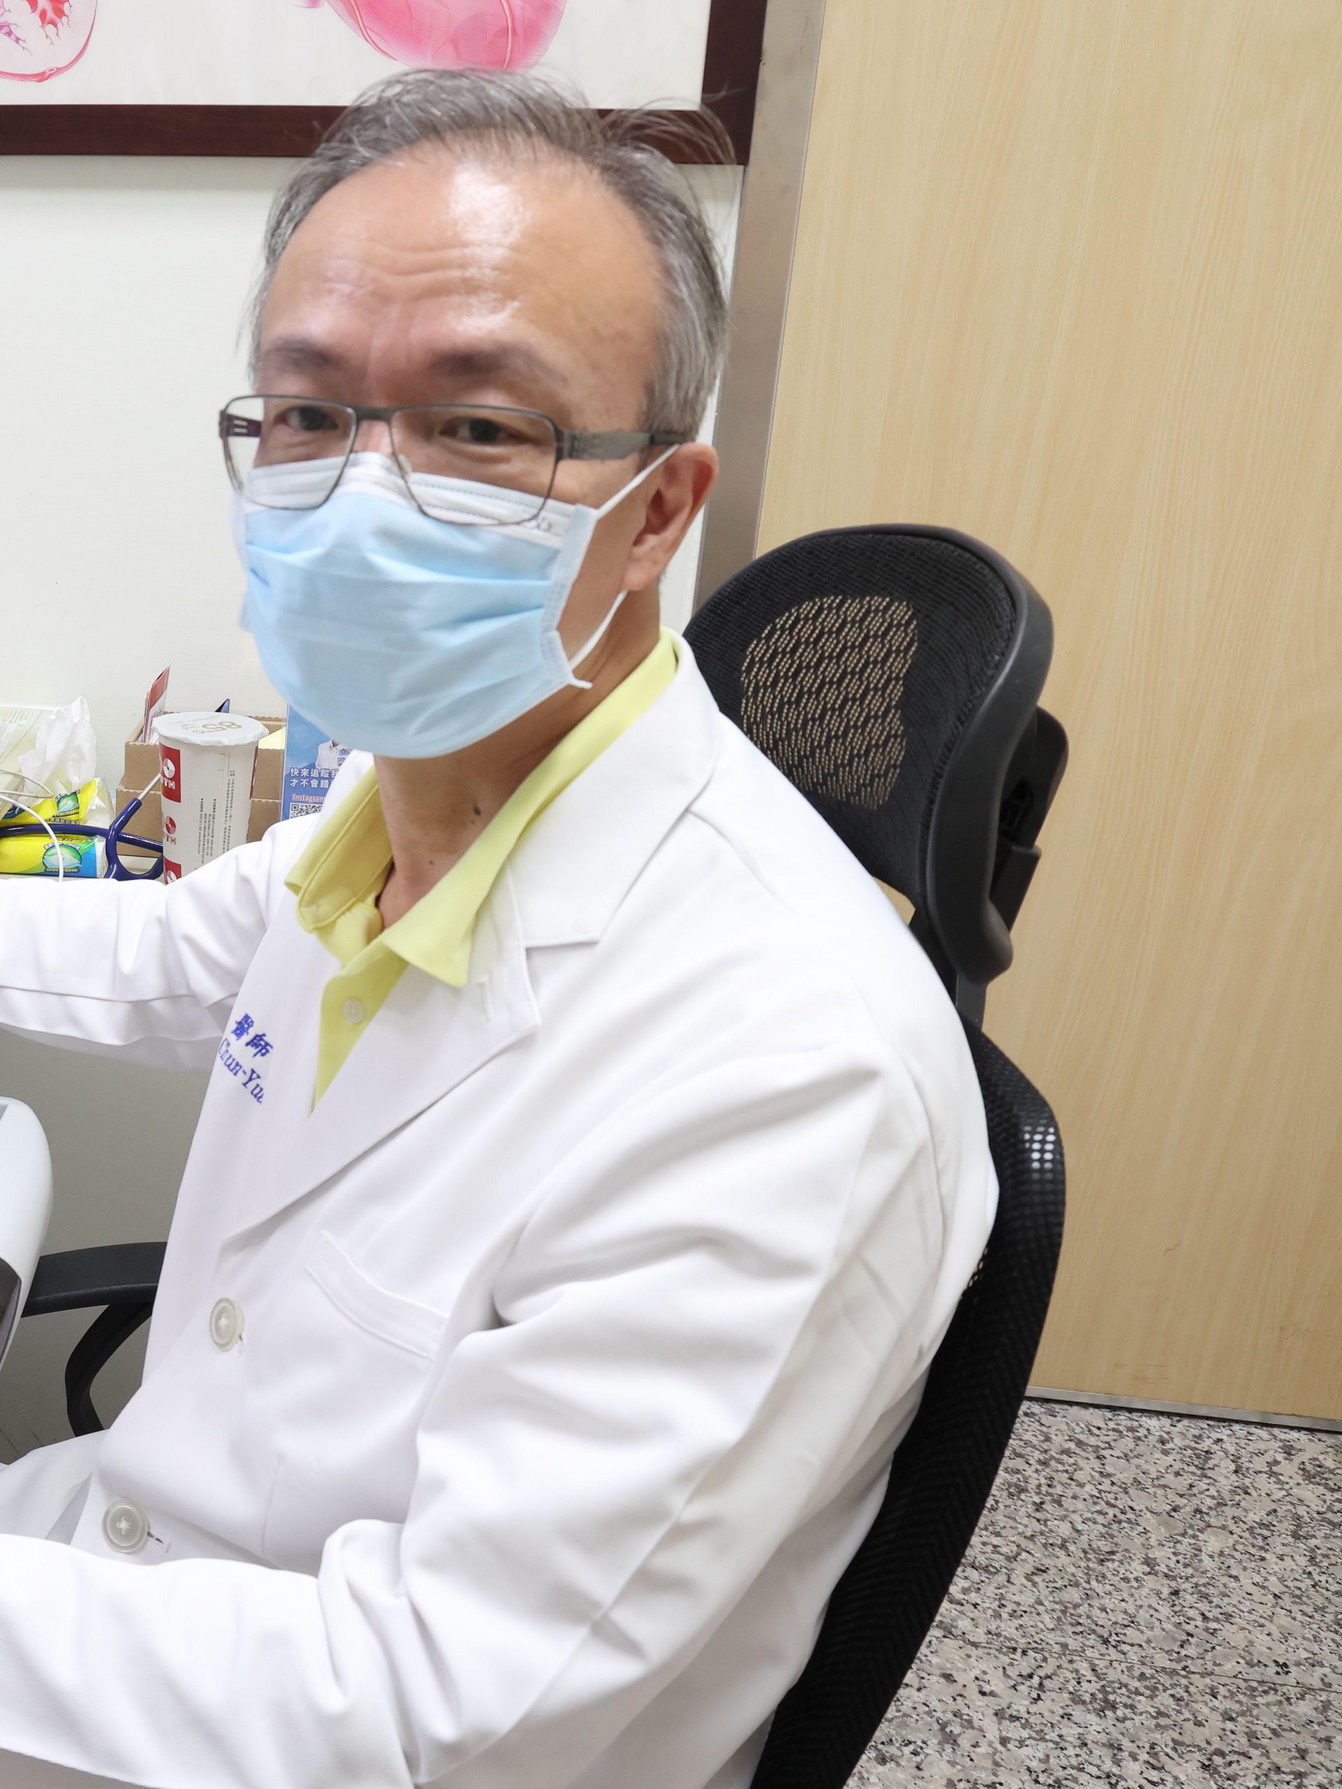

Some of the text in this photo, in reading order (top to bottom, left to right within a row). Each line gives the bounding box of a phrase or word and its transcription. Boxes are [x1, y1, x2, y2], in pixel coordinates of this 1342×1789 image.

[290, 779, 332, 789] 才不會錯
[231, 1012, 273, 1058] 醫師
